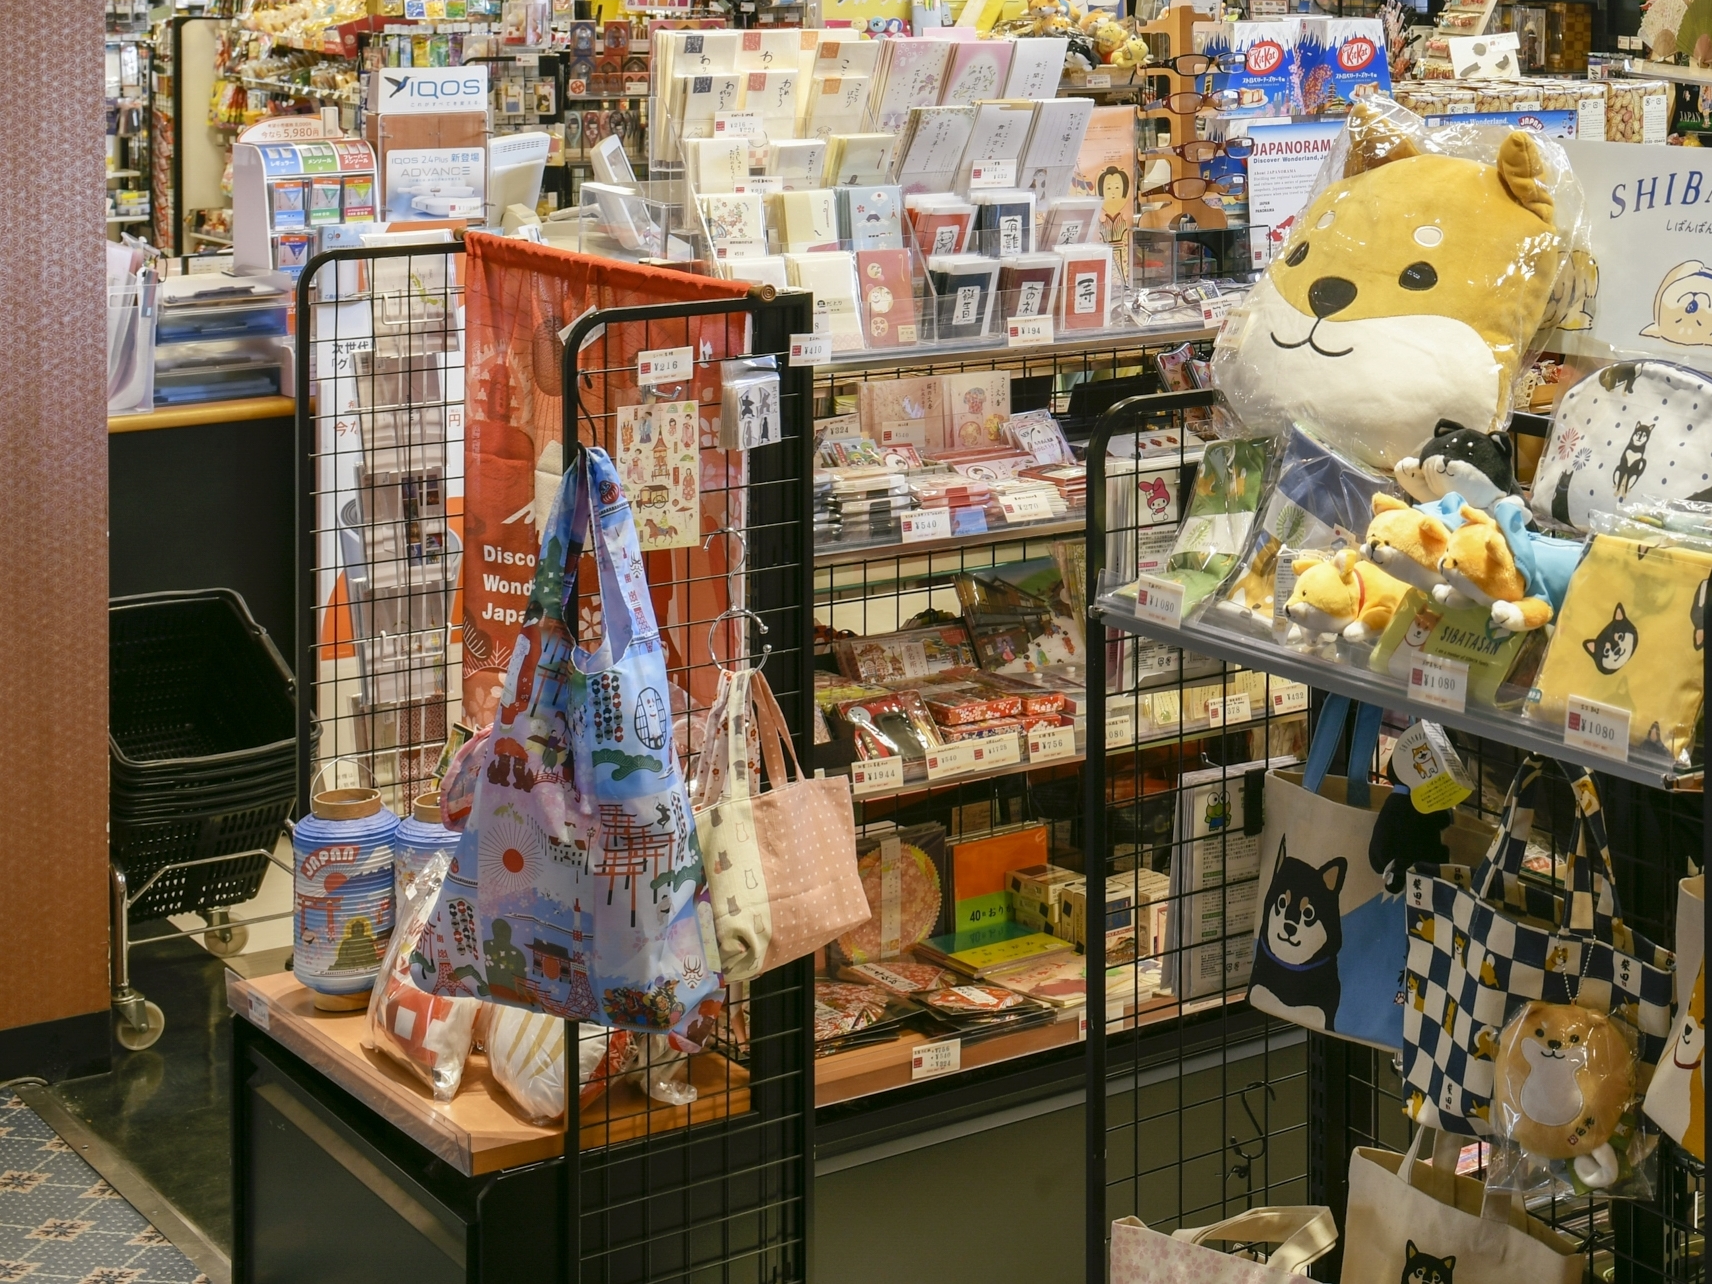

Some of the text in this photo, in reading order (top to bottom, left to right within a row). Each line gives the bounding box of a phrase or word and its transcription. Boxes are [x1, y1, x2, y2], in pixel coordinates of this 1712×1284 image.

[1253, 46, 1276, 69] KitKat
[1346, 44, 1369, 67] KitKat
[410, 79, 481, 99] IQOS
[1520, 117, 1543, 130] JAPAN
[262, 128, 319, 138] 今なら 5,980円
[391, 157, 418, 165] IQOS
[451, 153, 480, 163] 新登場
[400, 166, 470, 177] ADVANCE
[328, 231, 341, 241] glo
[1077, 278, 1095, 303] 寿
[1021, 326, 1041, 335] ¥194
[331, 341, 369, 354] 次世代
[804, 346, 823, 356] ¥410
[654, 361, 678, 372] ¥216
[1017, 502, 1039, 511] ¥270
[915, 519, 937, 530] ¥540
[1149, 595, 1175, 613] ¥1080
[1440, 626, 1502, 656] SIBATASAN
[1424, 674, 1456, 691] ¥1080
[1287, 692, 1304, 701] ¥432
[1227, 706, 1241, 716] 378
[1581, 718, 1615, 740] ¥1080
[1042, 738, 1063, 750] ¥756
[867, 769, 896, 782] ¥1944
[305, 847, 354, 877] JAPAN
